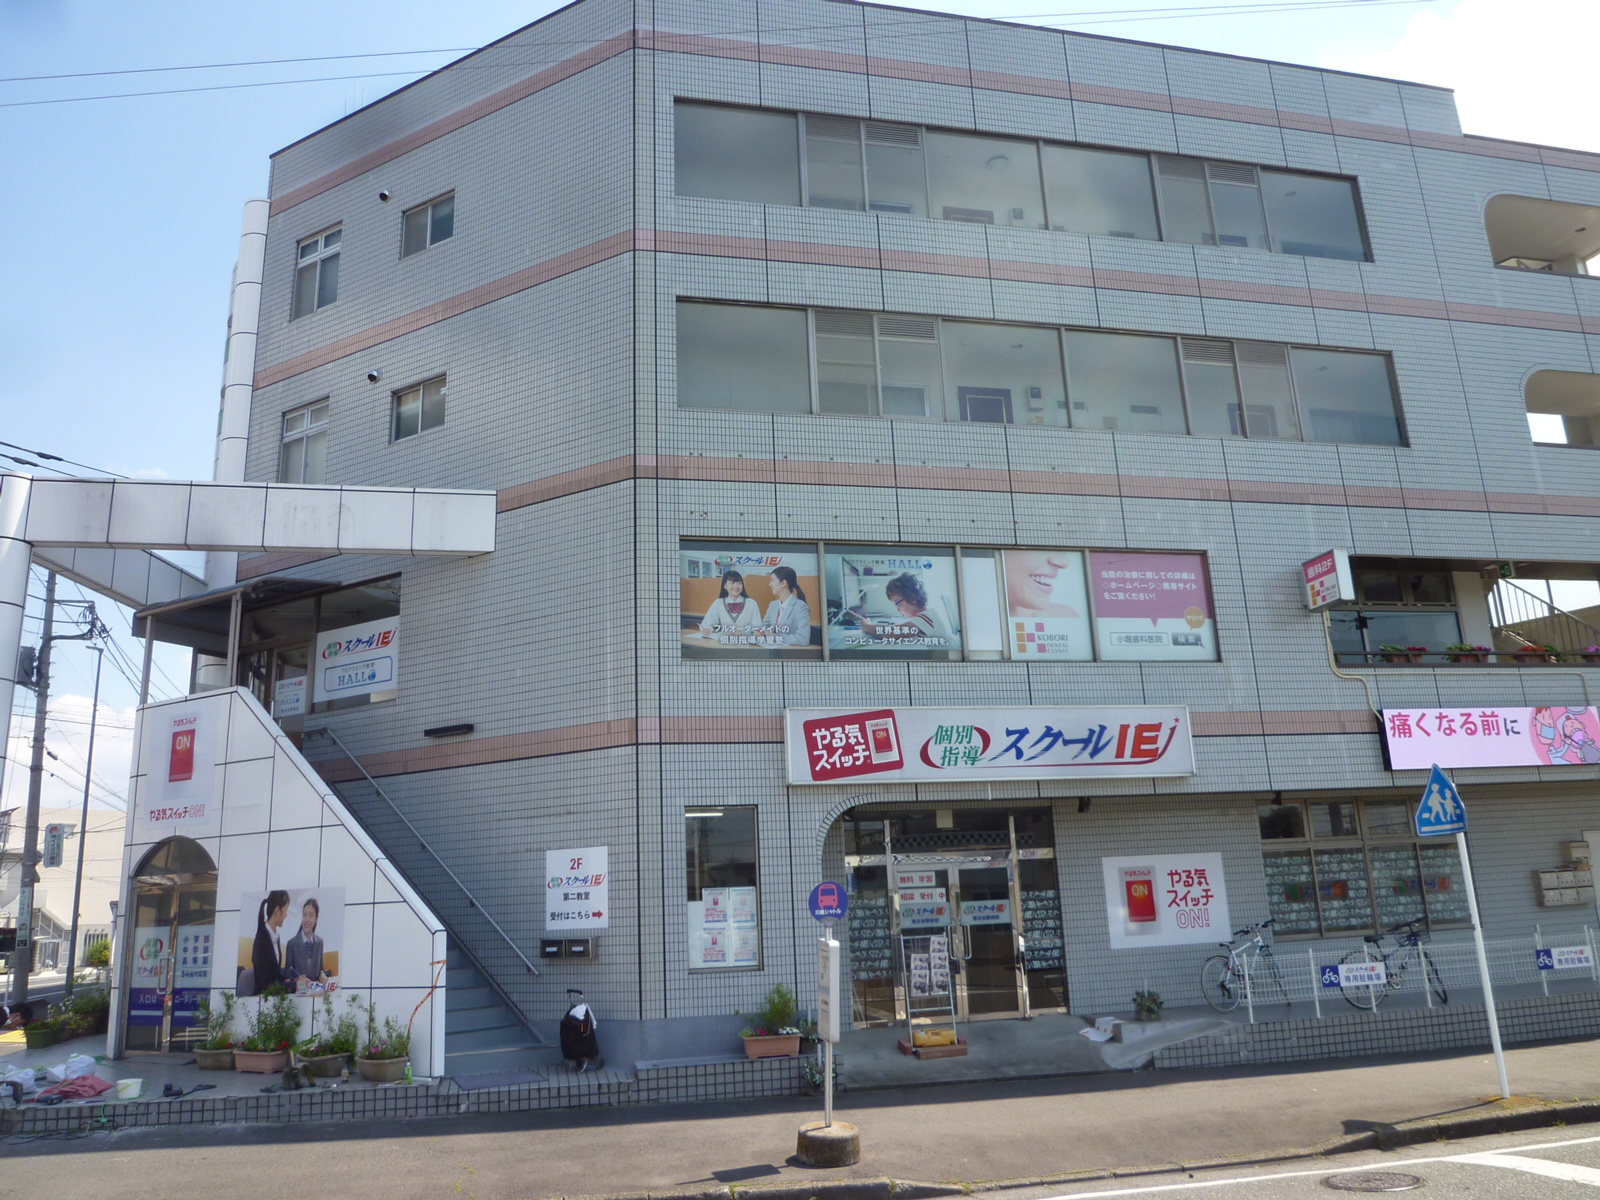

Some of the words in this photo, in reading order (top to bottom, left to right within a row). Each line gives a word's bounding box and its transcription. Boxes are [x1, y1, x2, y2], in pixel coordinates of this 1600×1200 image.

[713, 624, 790, 633] フルオーダーメイドの
[875, 626, 918, 635] 世界基準の
[720, 635, 784, 645] 個別指導学習塾
[1037, 634, 1069, 642] KOBORI
[1389, 711, 1521, 738] 痛くなる前に
[812, 724, 864, 749] やる気
[875, 730, 887, 739] ON
[934, 724, 974, 746] 個別
[176, 735, 191, 750] ON
[988, 722, 1164, 762] スクールIE
[813, 745, 870, 771] スイッチ
[940, 745, 981, 767] 指導
[570, 858, 583, 870] 2F
[1167, 868, 1210, 888] やる気
[563, 891, 590, 901] 第二教室
[1131, 885, 1149, 896] ON
[1167, 888, 1214, 908] スイッチ
[550, 911, 590, 921] 受付はこちら
[1176, 908, 1210, 929] ON!
[139, 995, 157, 1004] 入口は
